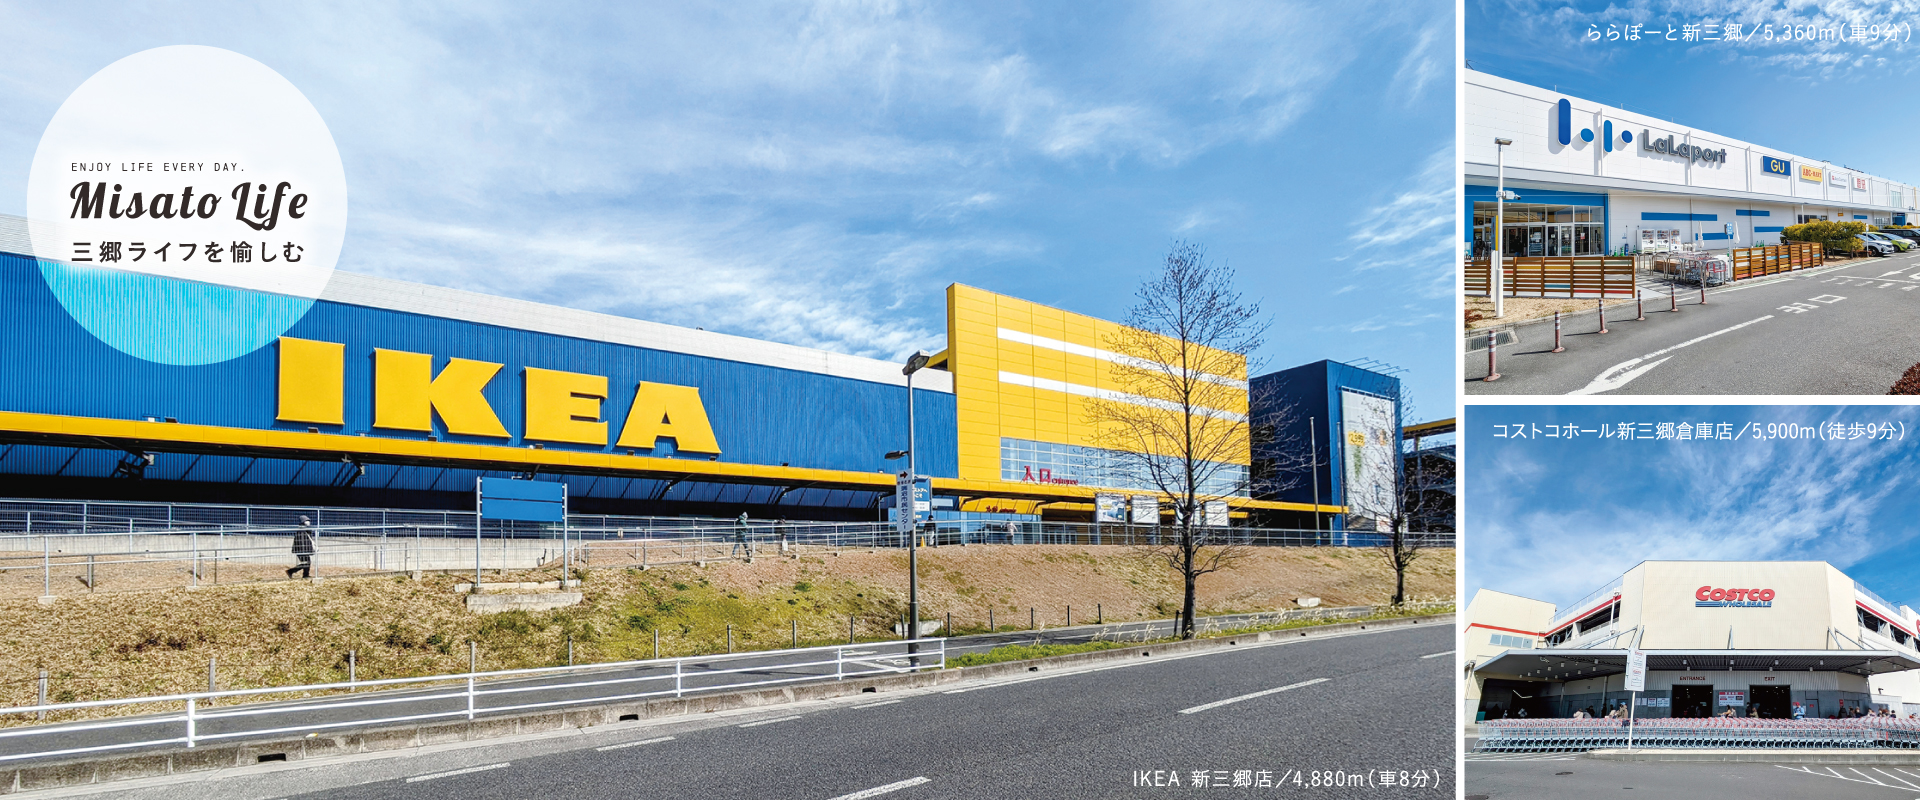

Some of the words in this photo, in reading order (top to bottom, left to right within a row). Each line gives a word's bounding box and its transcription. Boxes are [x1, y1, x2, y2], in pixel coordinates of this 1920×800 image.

[1643, 129, 1727, 163] LaLaport
[1770, 160, 1785, 173] GU
[275, 335, 723, 454] IKEA
[1021, 465, 1051, 483] 入口
[1695, 585, 1776, 602] COSTCO
